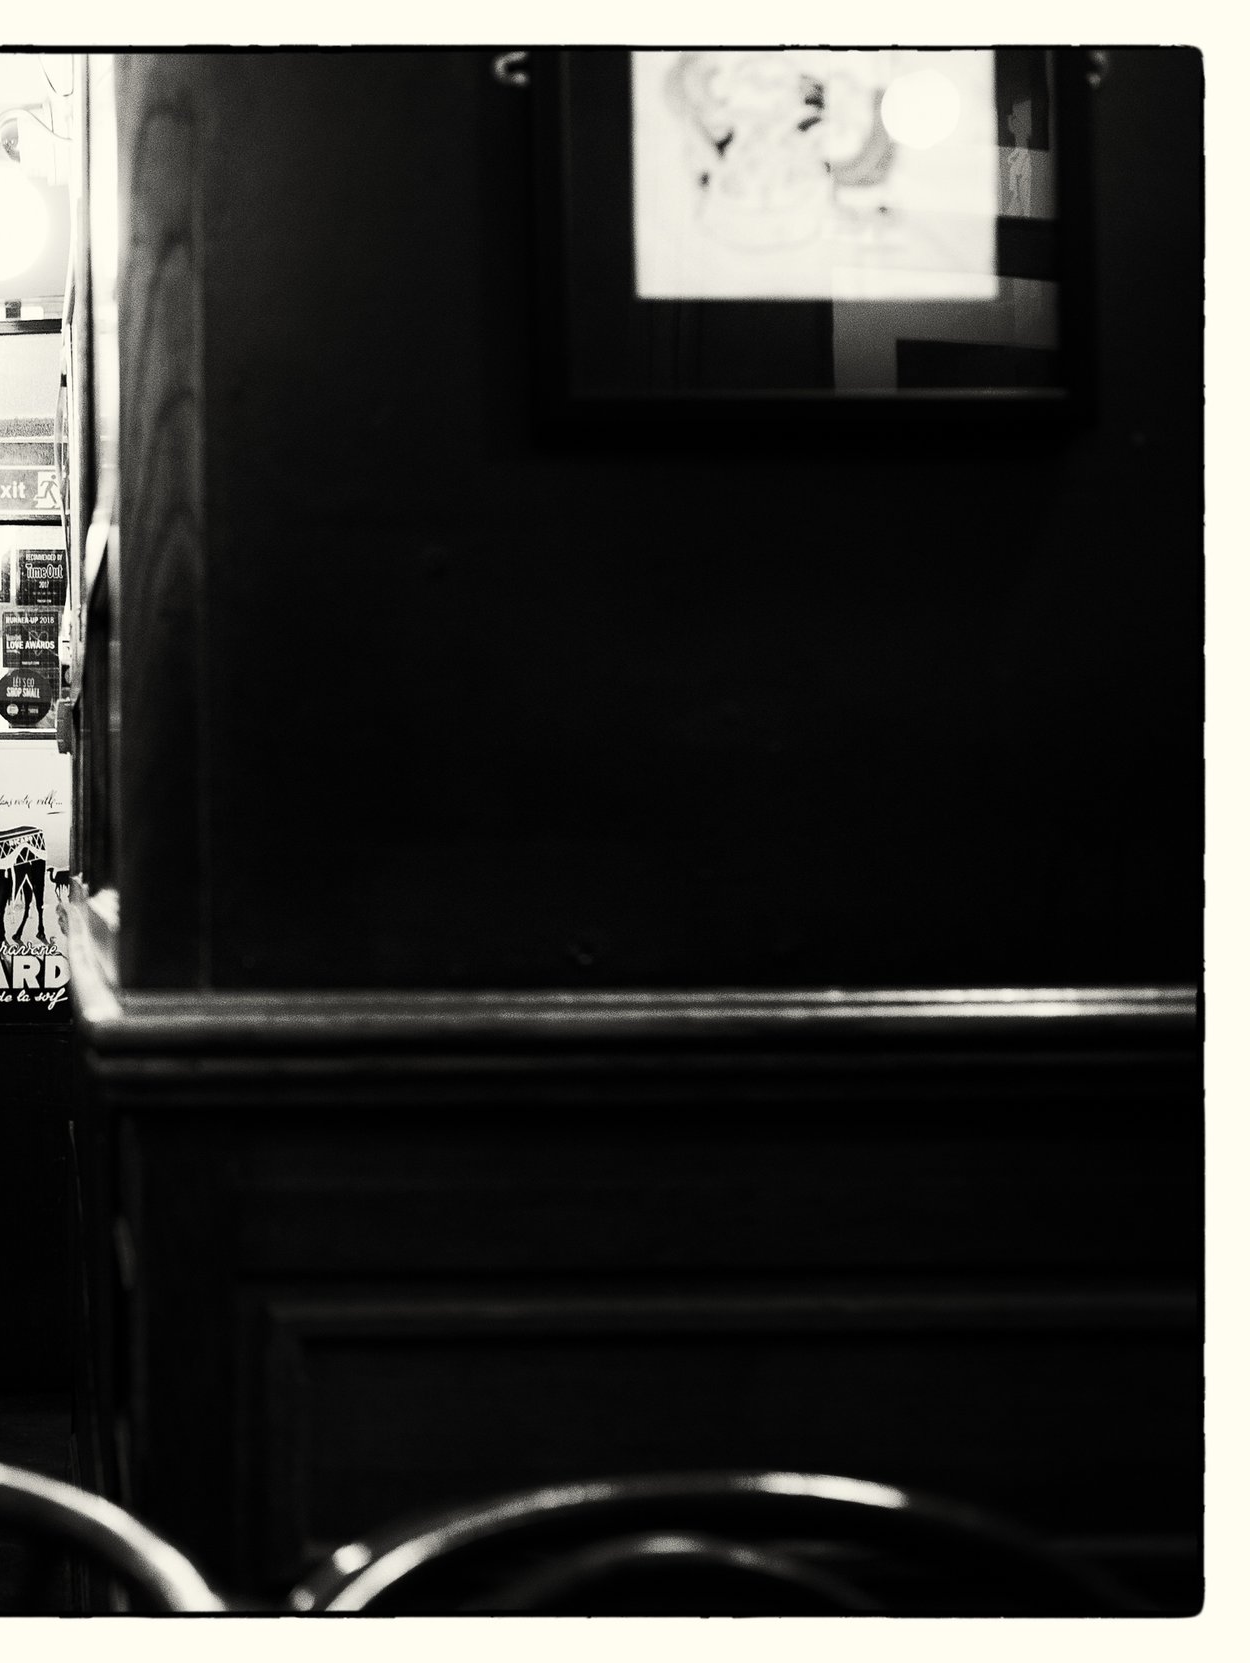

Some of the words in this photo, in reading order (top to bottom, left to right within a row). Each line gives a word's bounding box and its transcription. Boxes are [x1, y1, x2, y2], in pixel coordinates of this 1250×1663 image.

[39, 616, 55, 624] 2018
[6, 640, 24, 650] LOVE
[24, 640, 56, 650] AWARDS
[6, 686, 22, 698] SHOP
[22, 686, 41, 699] SMALL
[16, 989, 30, 1003] la
[34, 987, 69, 1010] soif
